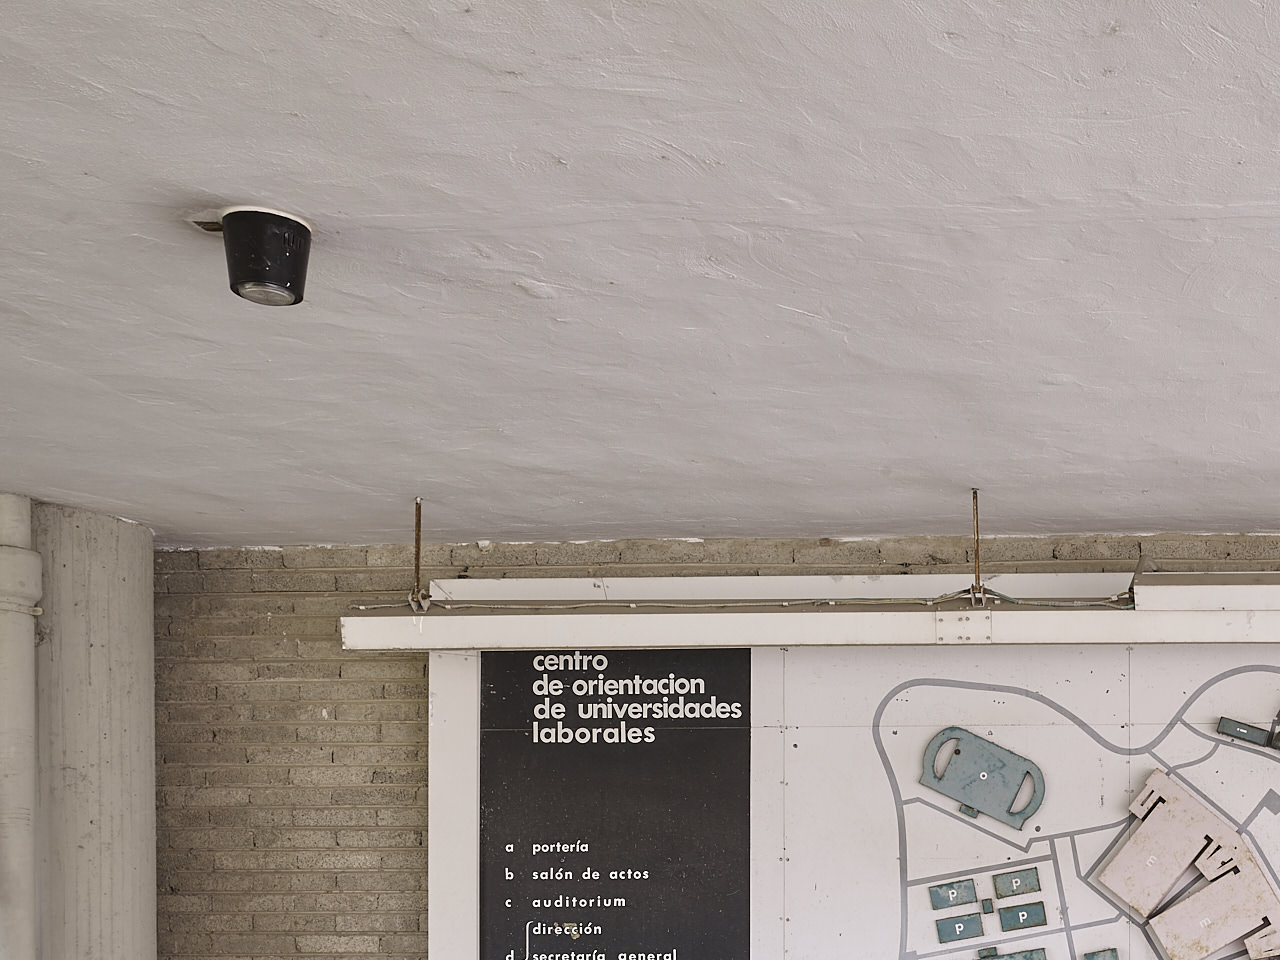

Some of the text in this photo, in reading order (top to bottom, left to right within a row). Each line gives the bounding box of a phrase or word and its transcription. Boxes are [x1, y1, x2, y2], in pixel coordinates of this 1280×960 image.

[532, 651, 608, 671] centro
[532, 673, 705, 695] de orientacion
[533, 696, 742, 719] de universidades
[532, 722, 656, 743] laborales
[979, 772, 988, 780] o
[505, 840, 589, 855] a portería
[505, 868, 649, 880] b salón de actos
[1012, 877, 1021, 889] p
[949, 889, 957, 901] p
[505, 896, 626, 908] c auditorium
[1018, 911, 1028, 922] p
[532, 922, 602, 935] dirección
[955, 923, 964, 934] p
